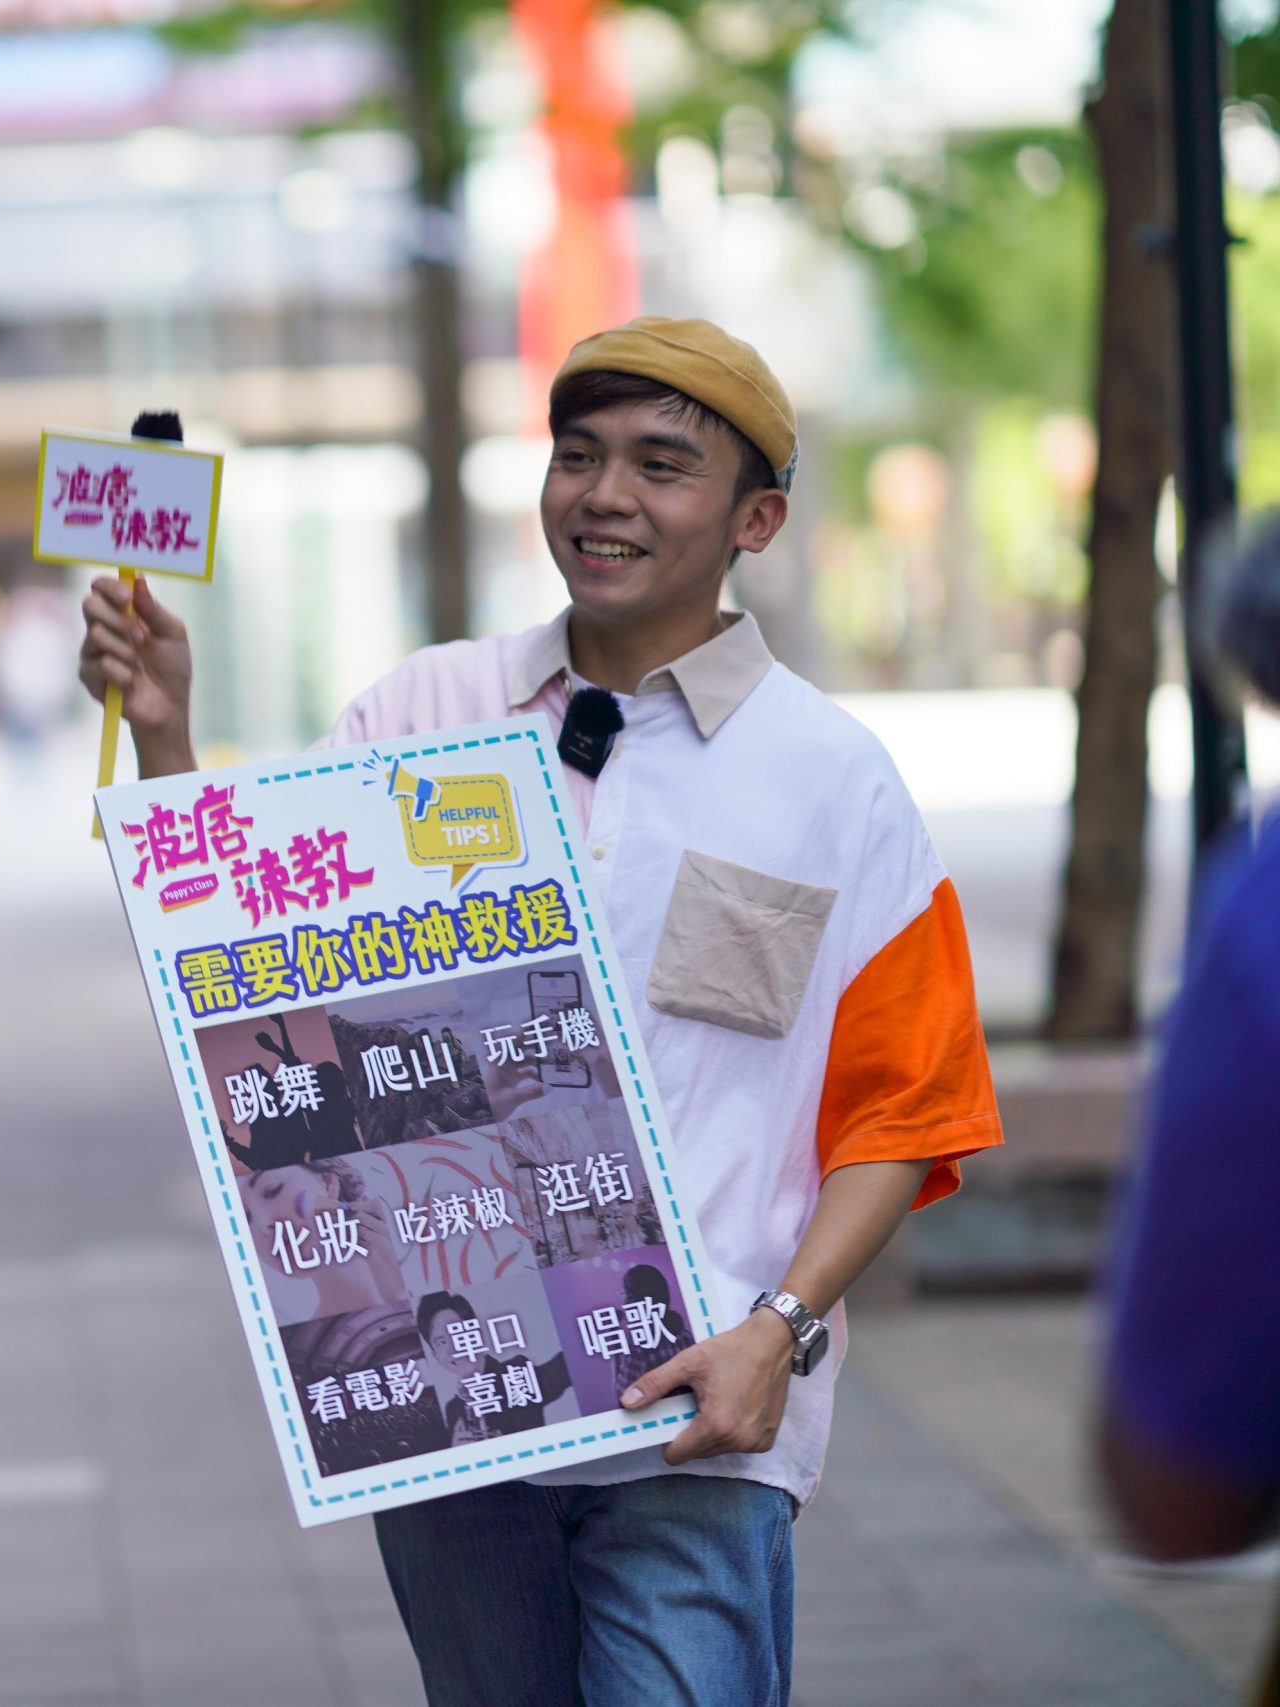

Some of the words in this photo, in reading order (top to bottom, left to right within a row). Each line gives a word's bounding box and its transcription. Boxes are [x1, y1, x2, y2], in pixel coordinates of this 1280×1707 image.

[439, 806, 501, 822] HELPFUL
[163, 885, 194, 901] Poppy's
[193, 879, 214, 892] Class
[230, 826, 374, 929] 辣教
[179, 880, 577, 1016] 需要你的神救援
[359, 1034, 459, 1100] 爬山
[479, 1007, 601, 1068] 玩手機
[224, 1062, 325, 1126] 跳舞
[394, 1185, 515, 1246] 吃辣椒
[536, 1151, 635, 1216] 逛街
[270, 1208, 370, 1275] 化妝
[445, 1313, 527, 1363] 單口
[576, 1296, 678, 1360] 唱歌
[306, 1358, 426, 1424] 看電影
[461, 1360, 543, 1418] 喜劇
